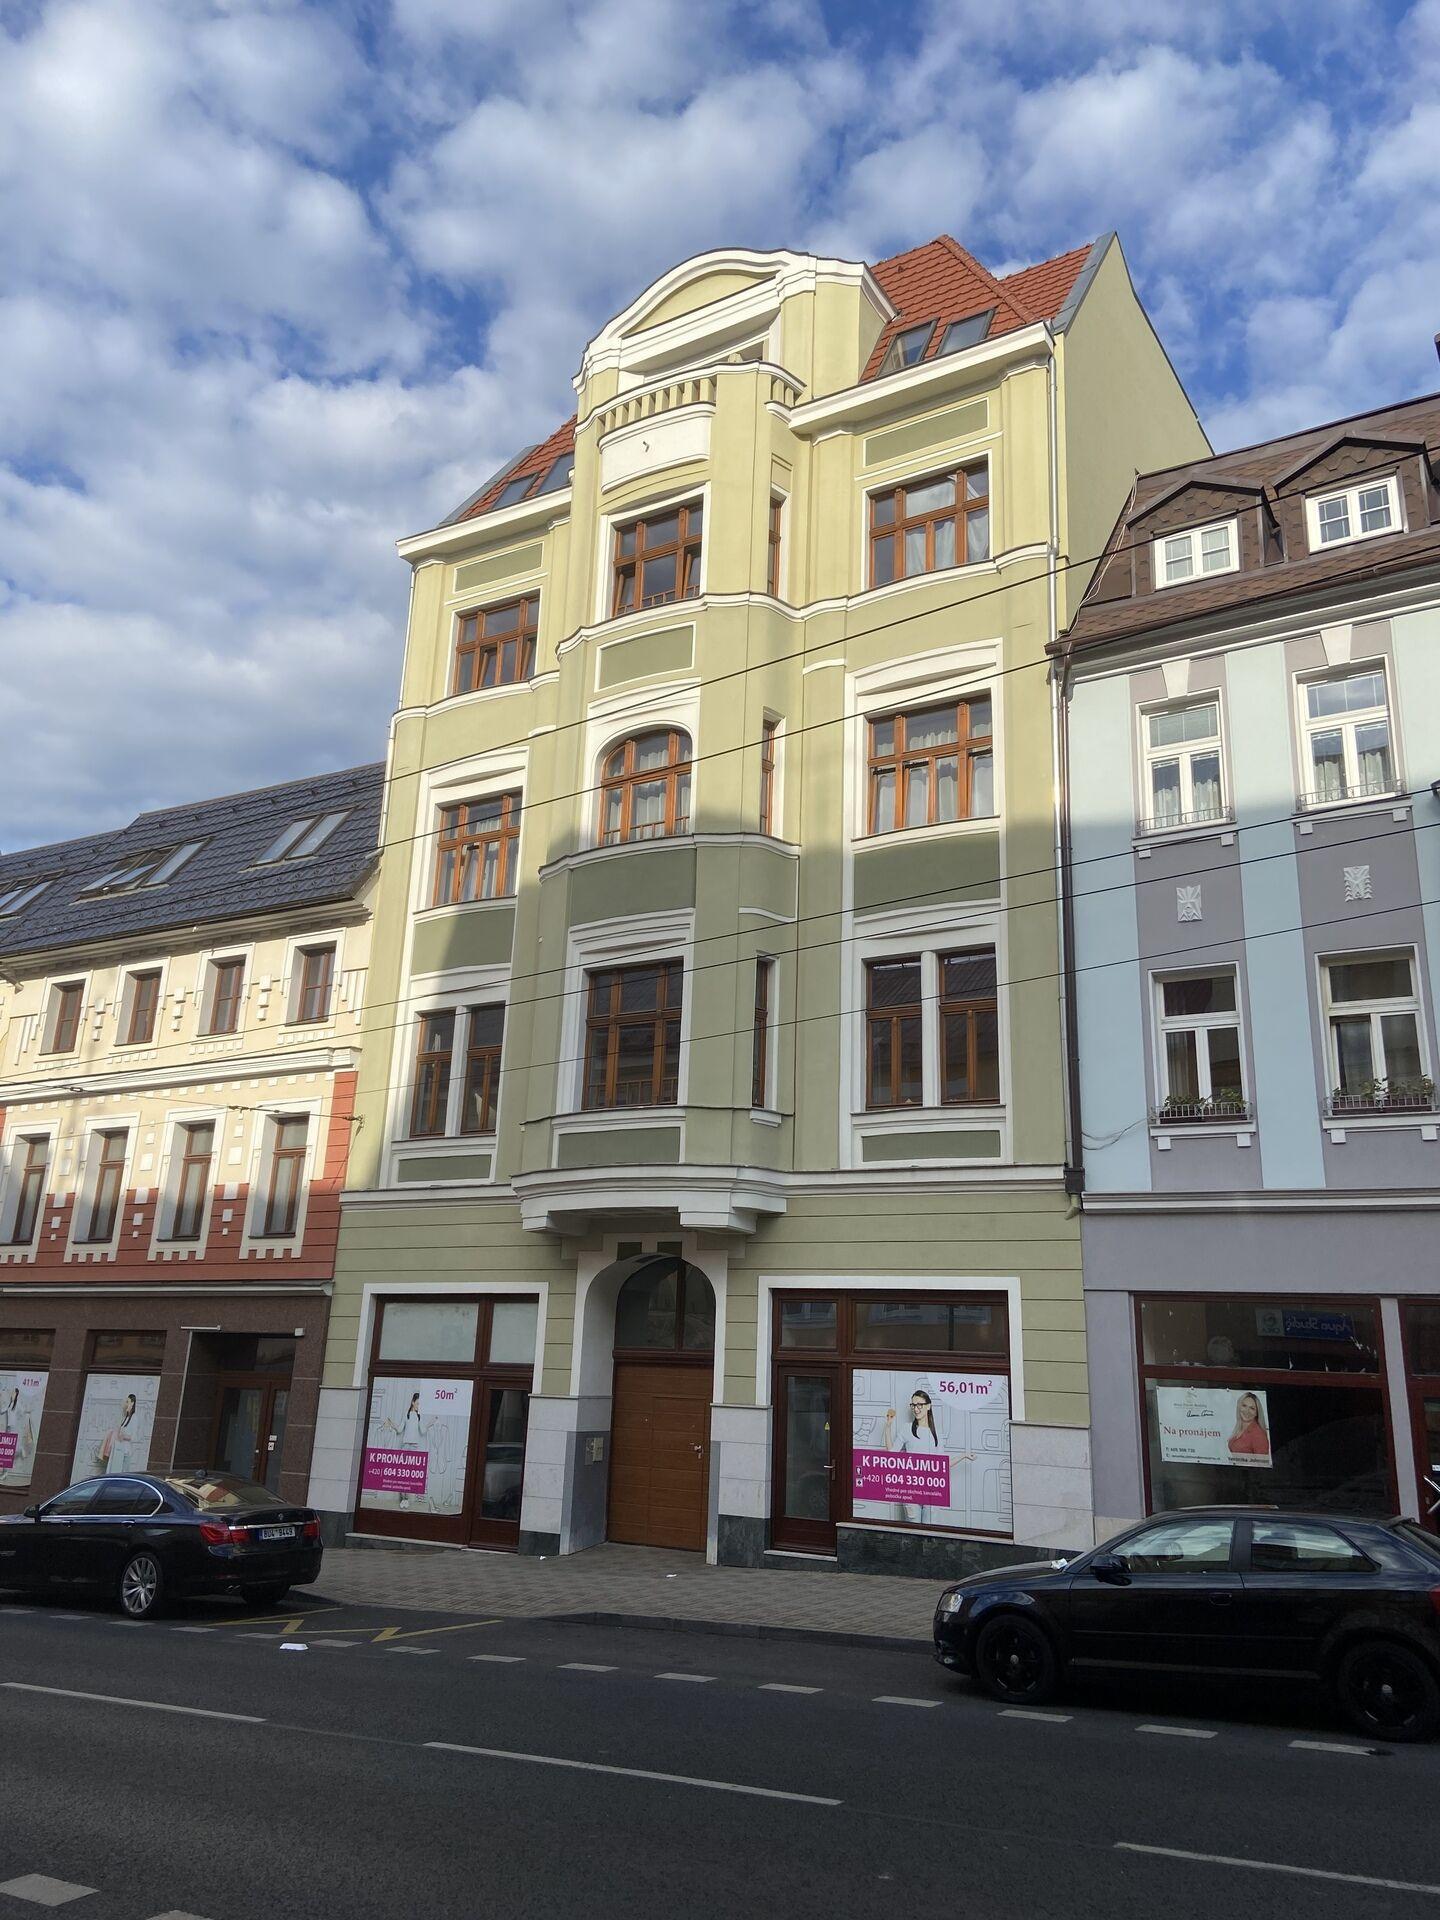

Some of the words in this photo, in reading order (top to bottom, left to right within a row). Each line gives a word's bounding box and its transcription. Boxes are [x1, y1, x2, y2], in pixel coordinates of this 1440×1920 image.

[1163, 1426, 1177, 1435] Na
[1178, 1427, 1221, 1438] pronájem
[369, 1452, 376, 1462] K
[376, 1453, 422, 1466] PRONÁJMU
[422, 1456, 426, 1466] !
[862, 1455, 870, 1467] K
[872, 1456, 940, 1473] PRONÁJMU
[942, 1461, 946, 1473] !
[383, 1467, 396, 1476] 604
[397, 1468, 410, 1478] 330
[410, 1470, 424, 1479] 000
[862, 1474, 880, 1483] +420
[885, 1473, 904, 1485] 604
[906, 1475, 925, 1486] 330
[926, 1477, 946, 1488] 000
